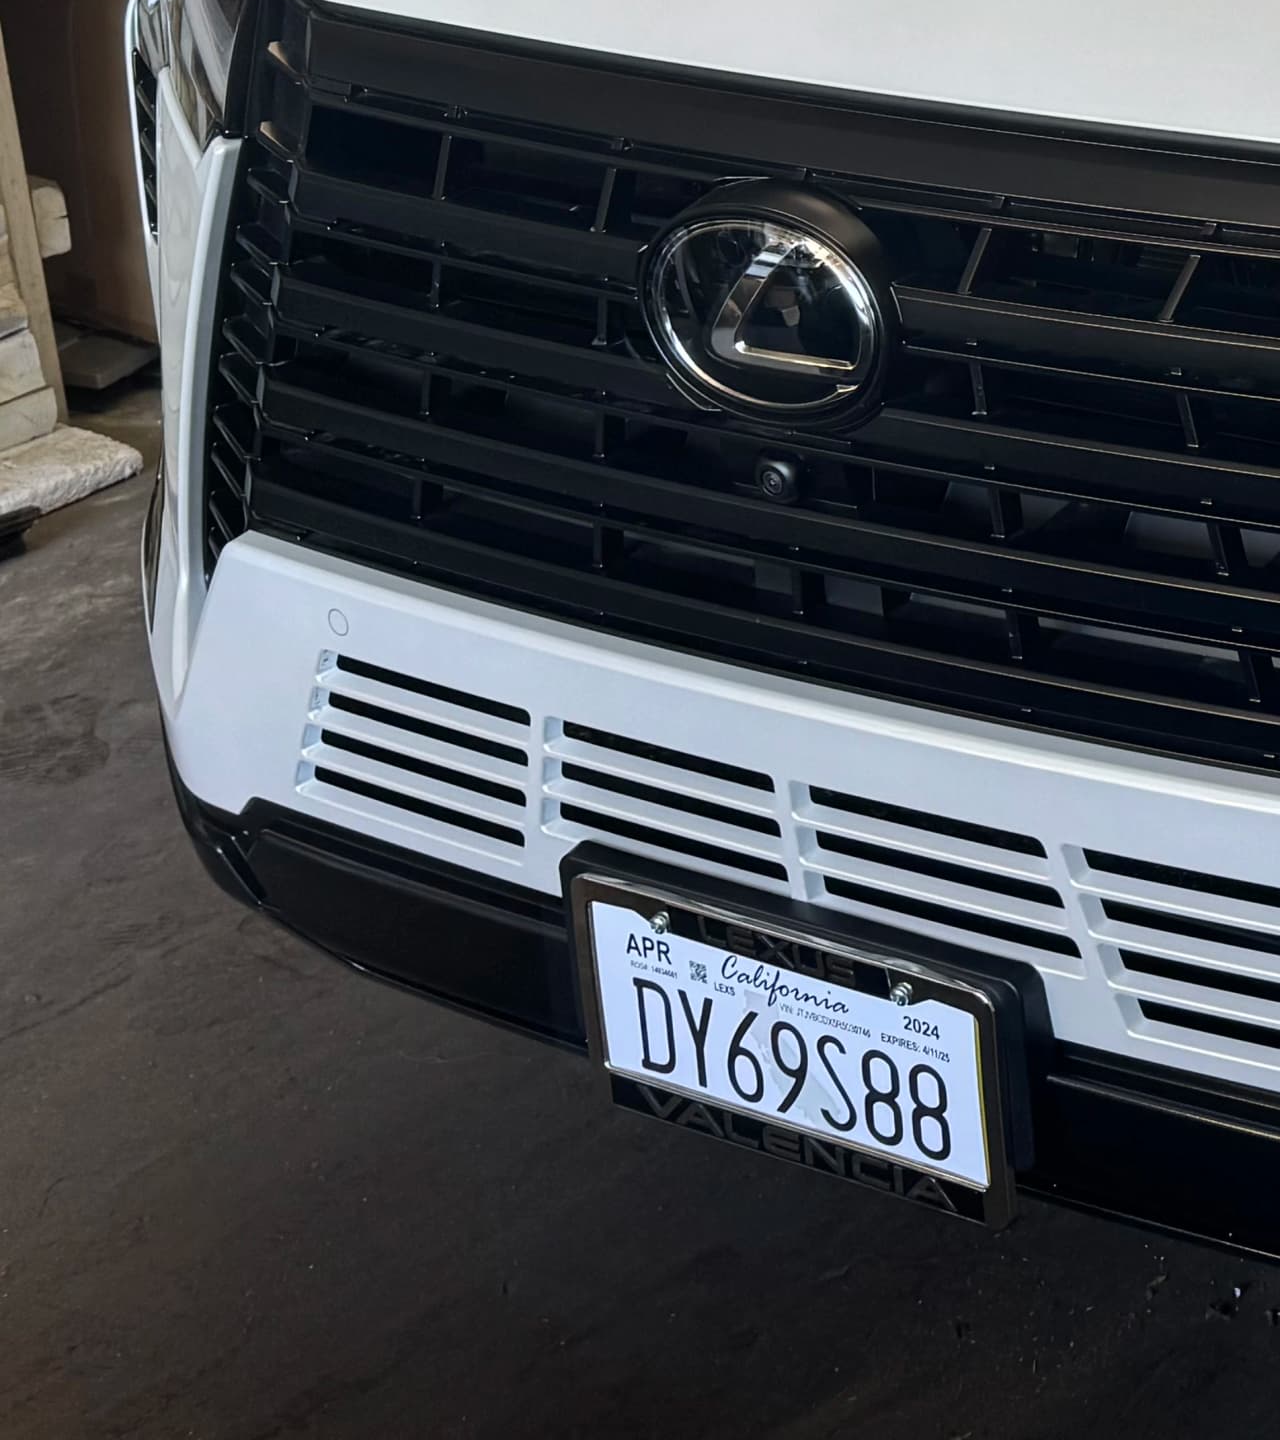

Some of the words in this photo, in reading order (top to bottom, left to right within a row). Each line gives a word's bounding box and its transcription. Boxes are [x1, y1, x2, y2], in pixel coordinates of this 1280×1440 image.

[626, 932, 673, 965] APR
[713, 982, 736, 997] LEXS
[720, 954, 850, 1016] California
[902, 1015, 941, 1041] 2024
[632, 976, 952, 1161] DY69S88
[635, 1082, 960, 1213] VALENCIA
